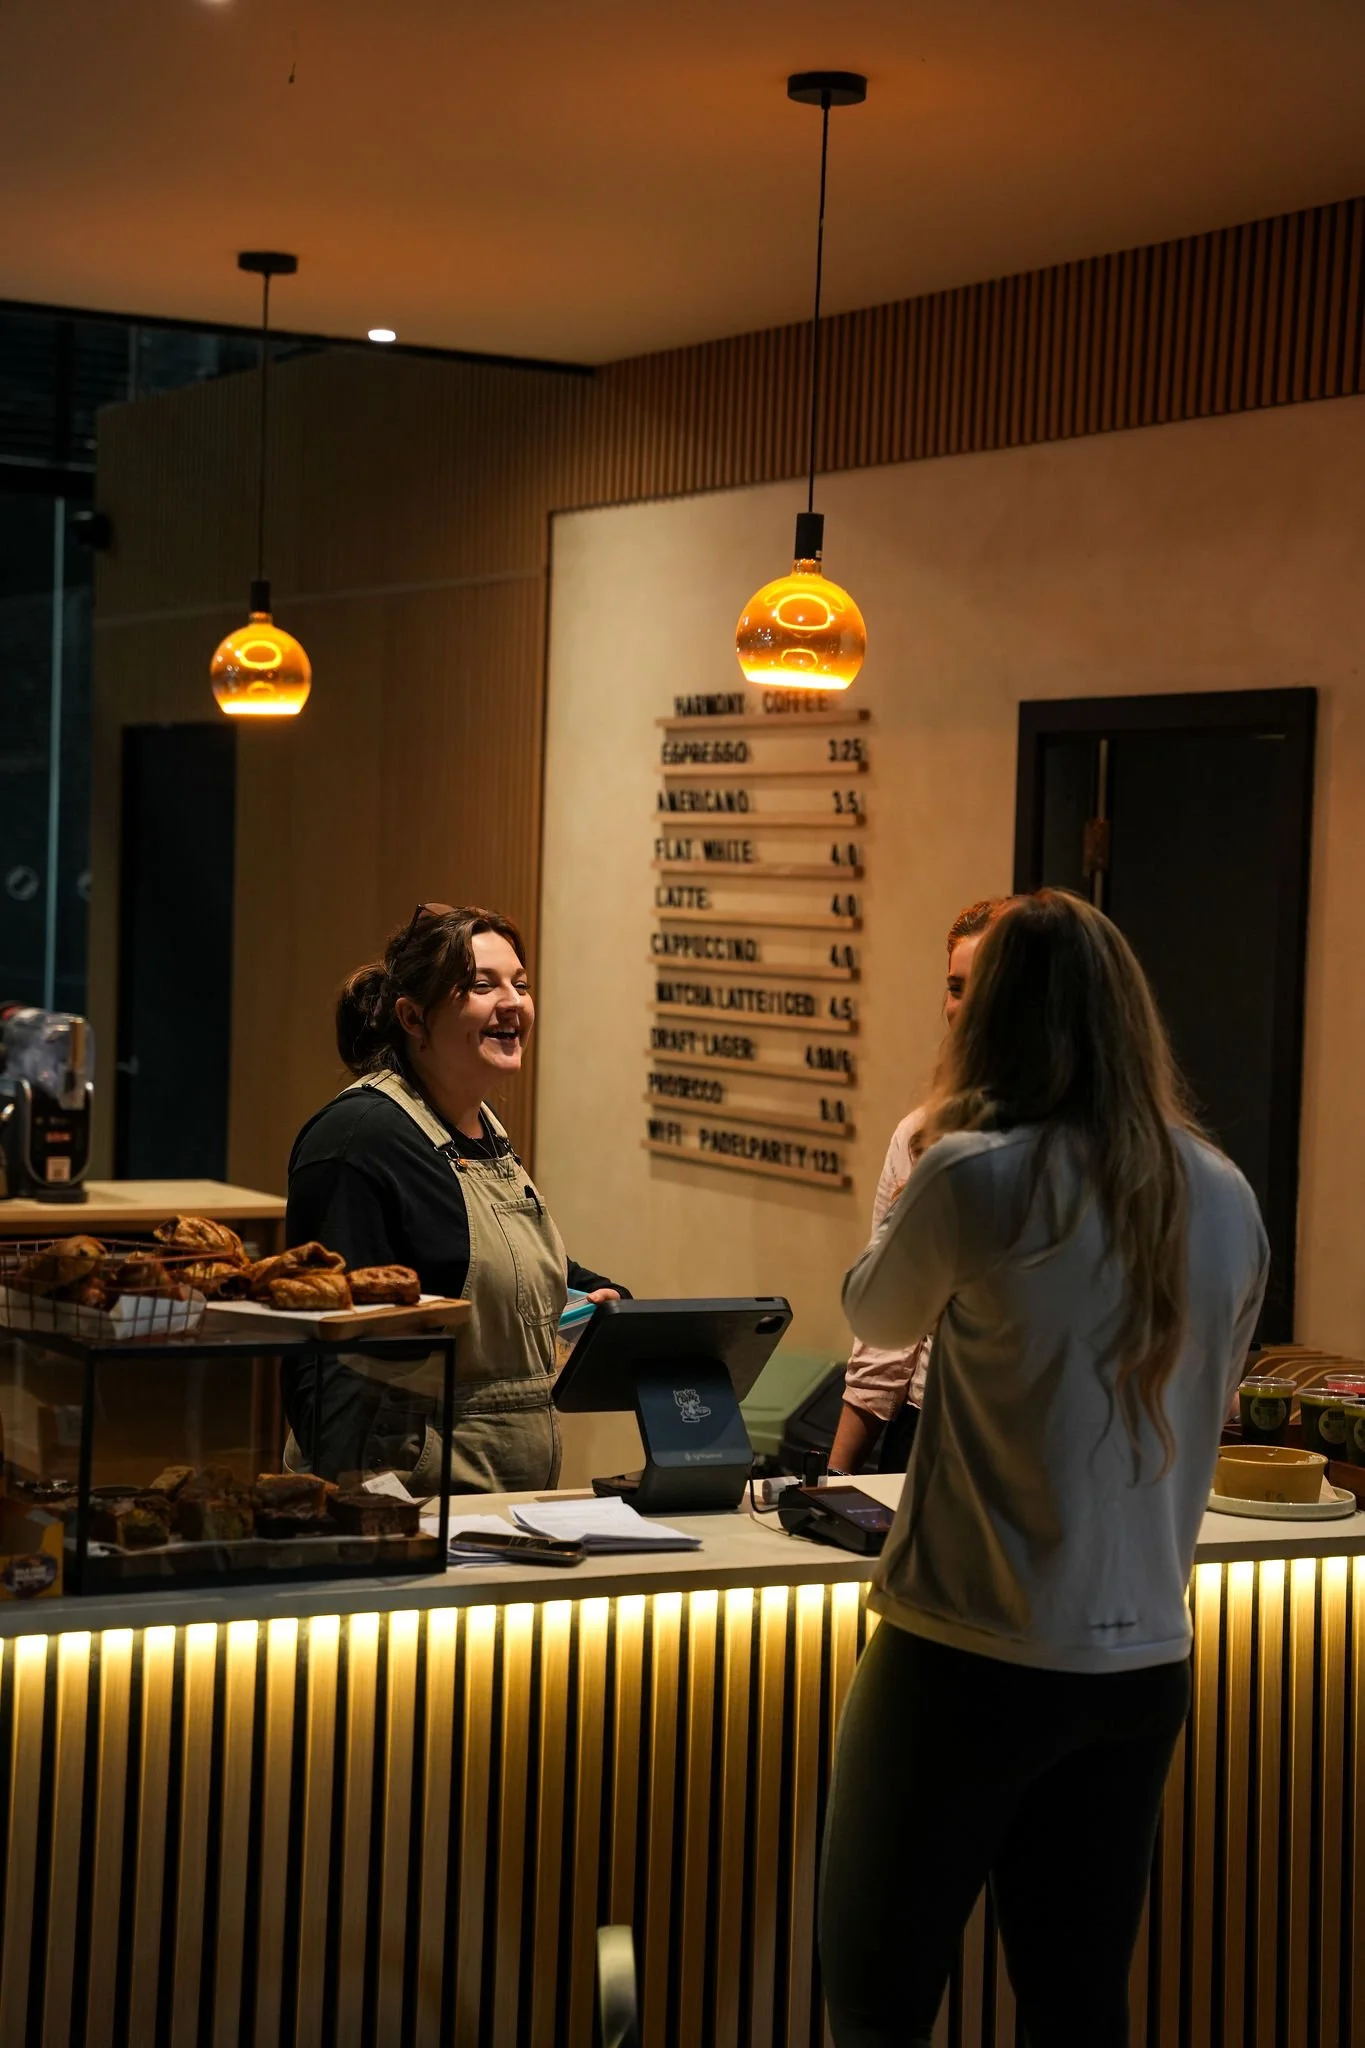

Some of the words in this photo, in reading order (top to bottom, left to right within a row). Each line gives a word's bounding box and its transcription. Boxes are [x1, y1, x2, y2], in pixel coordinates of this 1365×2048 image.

[675, 693, 746, 716] HARMONY
[763, 691, 830, 714] COFFEE
[662, 741, 748, 764] ESPRESSO
[658, 790, 749, 814] AMERICANO
[655, 840, 693, 861] FLAT
[704, 841, 753, 862] WHITE
[656, 887, 708, 910] LATTE
[651, 934, 757, 963] CAPPUCCINO
[656, 982, 714, 1008] MATCHA
[652, 1028, 697, 1053] DRAFT
[704, 1034, 755, 1059] LAGER
[649, 1074, 724, 1103] PROSECCO
